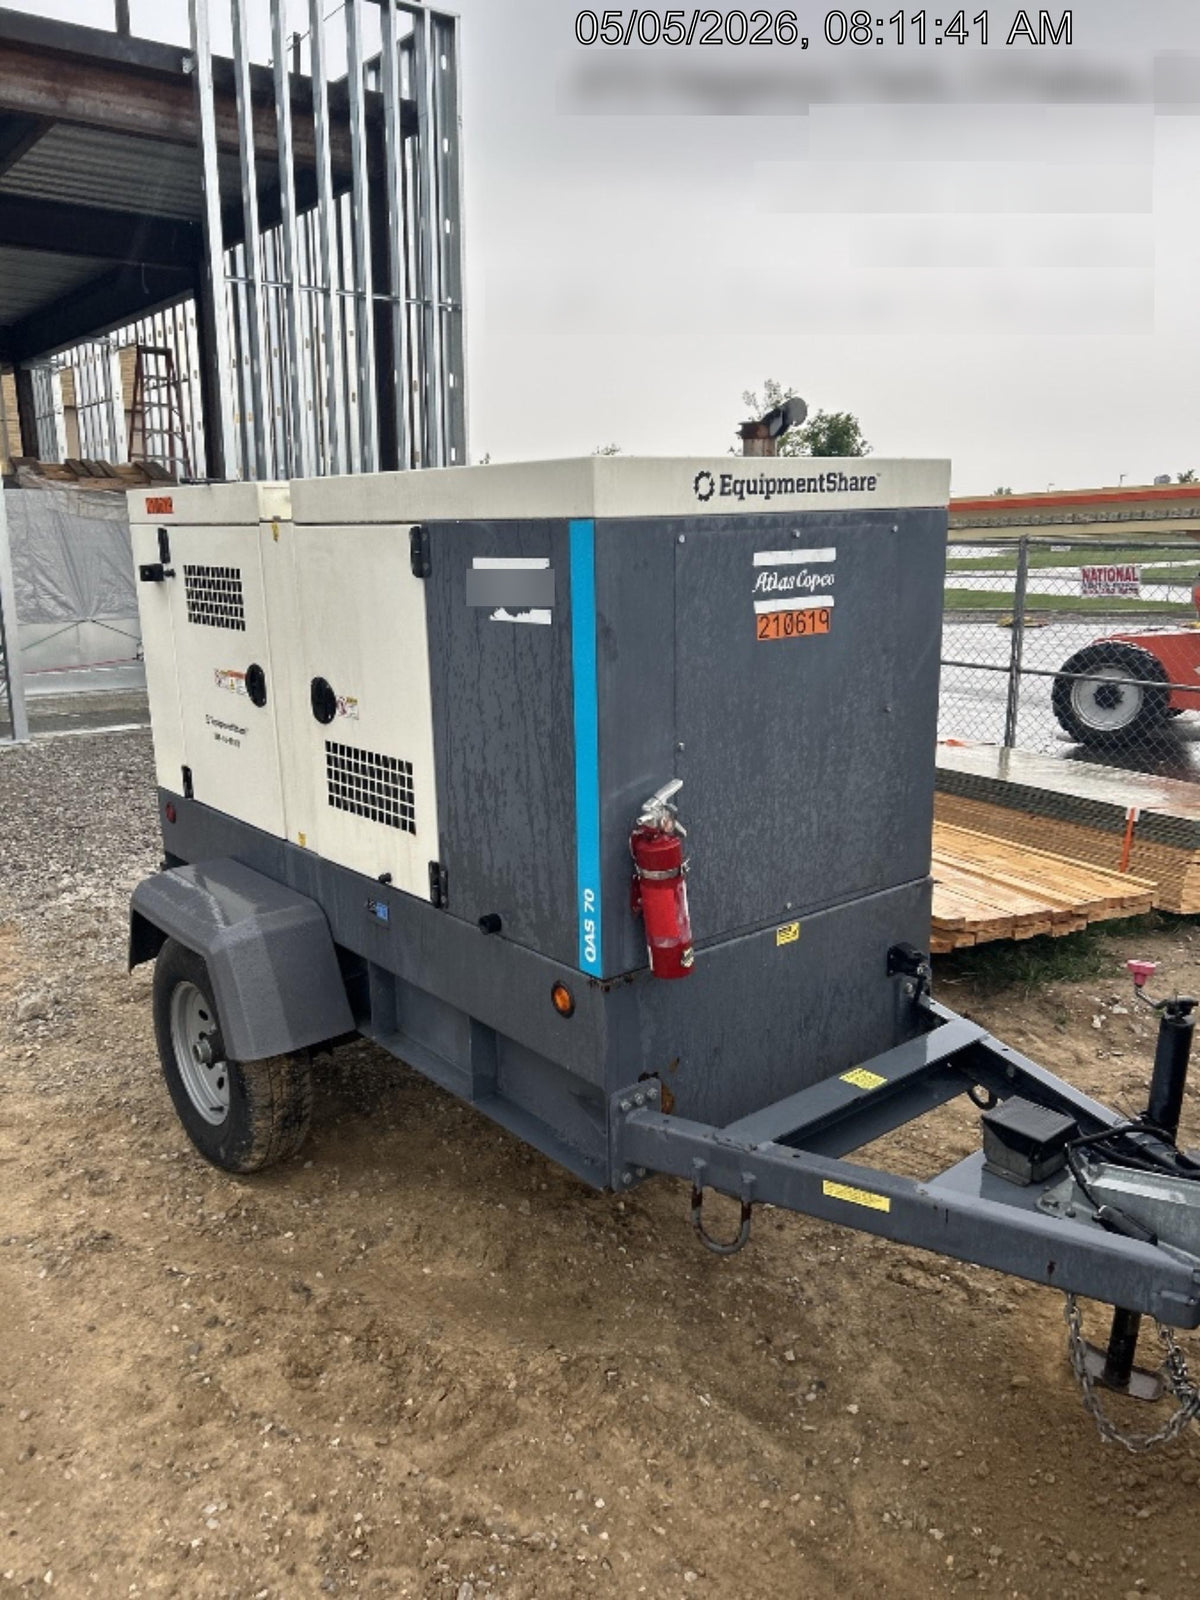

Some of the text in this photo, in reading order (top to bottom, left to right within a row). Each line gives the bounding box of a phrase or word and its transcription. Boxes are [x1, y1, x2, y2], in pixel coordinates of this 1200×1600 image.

[720, 472, 877, 500] EquipmentShare
[752, 568, 835, 593] Atlas Copco
[1082, 566, 1139, 582] NATIONAL
[758, 609, 830, 639] 210619
[584, 888, 595, 913] 70
